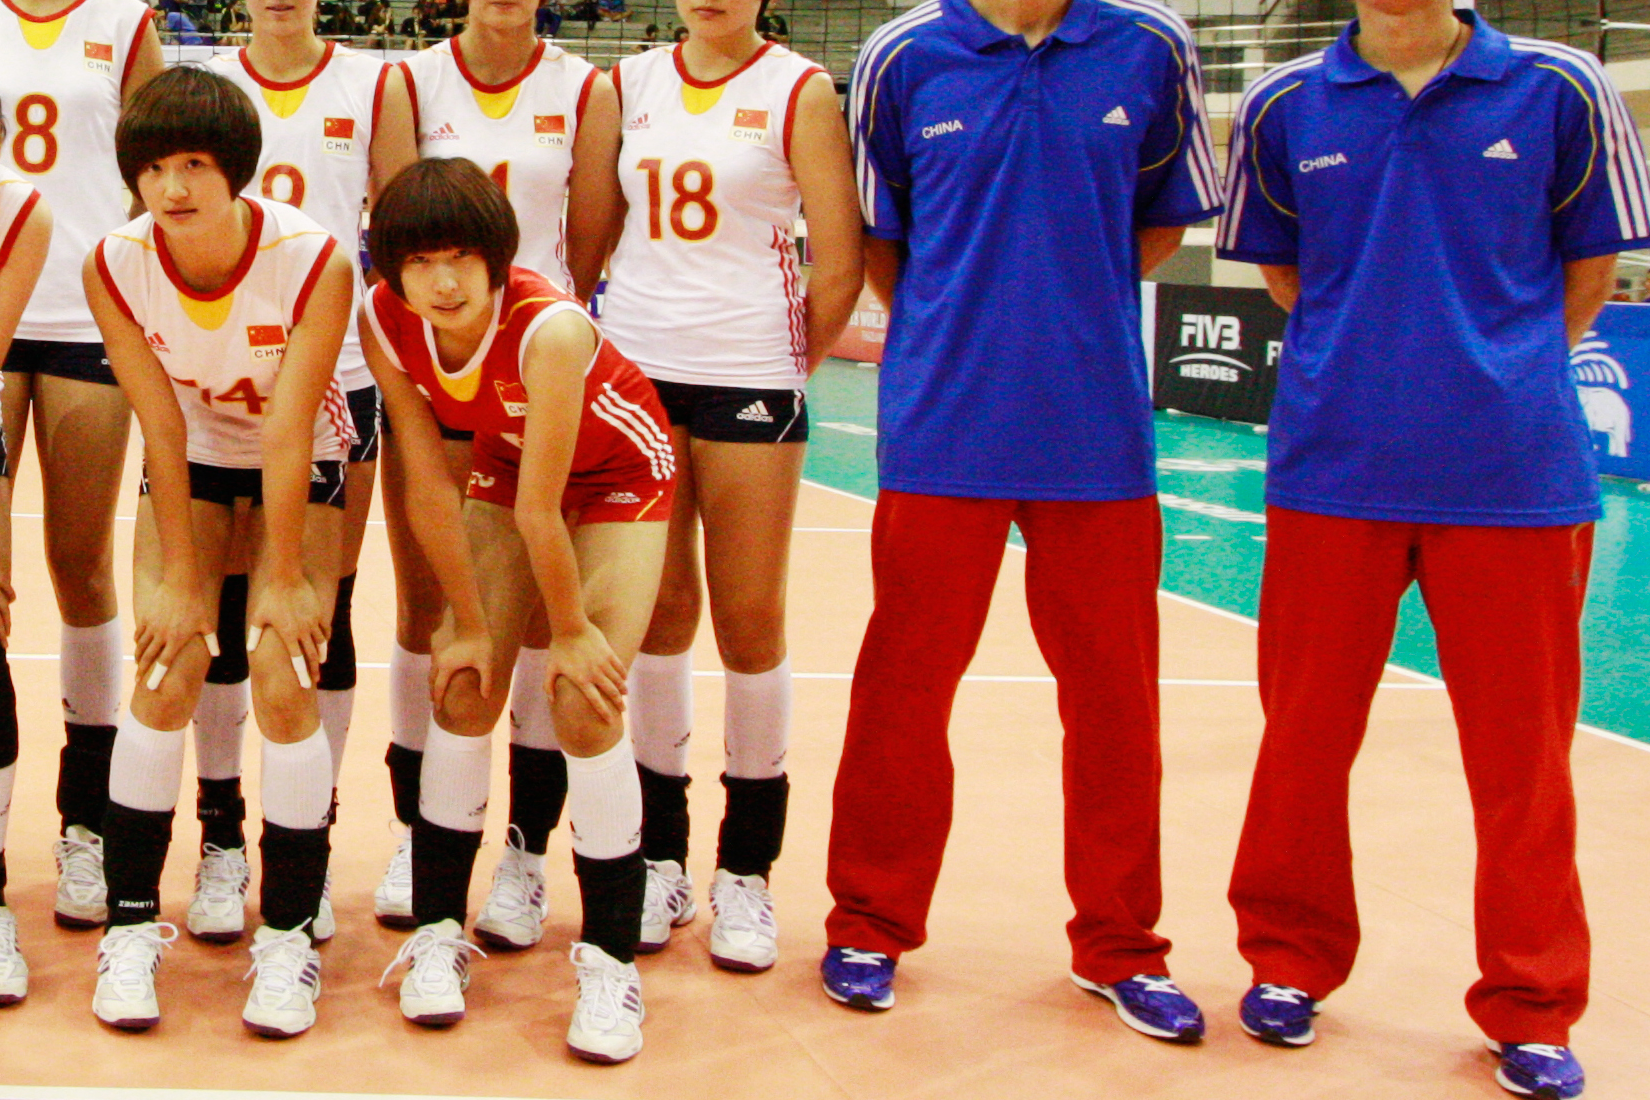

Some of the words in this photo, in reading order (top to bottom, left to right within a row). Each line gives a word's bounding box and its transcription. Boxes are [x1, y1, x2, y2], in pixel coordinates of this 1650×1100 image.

[87, 61, 111, 73] CHN
[12, 91, 60, 176] 8
[734, 129, 763, 141] CHN
[922, 118, 963, 140] CHINA
[428, 132, 460, 141] adidas
[538, 136, 564, 146] CHN
[326, 140, 350, 151] CHN
[1298, 152, 1348, 173] CHINA
[636, 158, 719, 242] 18
[1180, 313, 1241, 350] FIVB
[254, 346, 286, 359] CHN
[1179, 363, 1239, 382] HEROES
[736, 412, 774, 423] adidas
